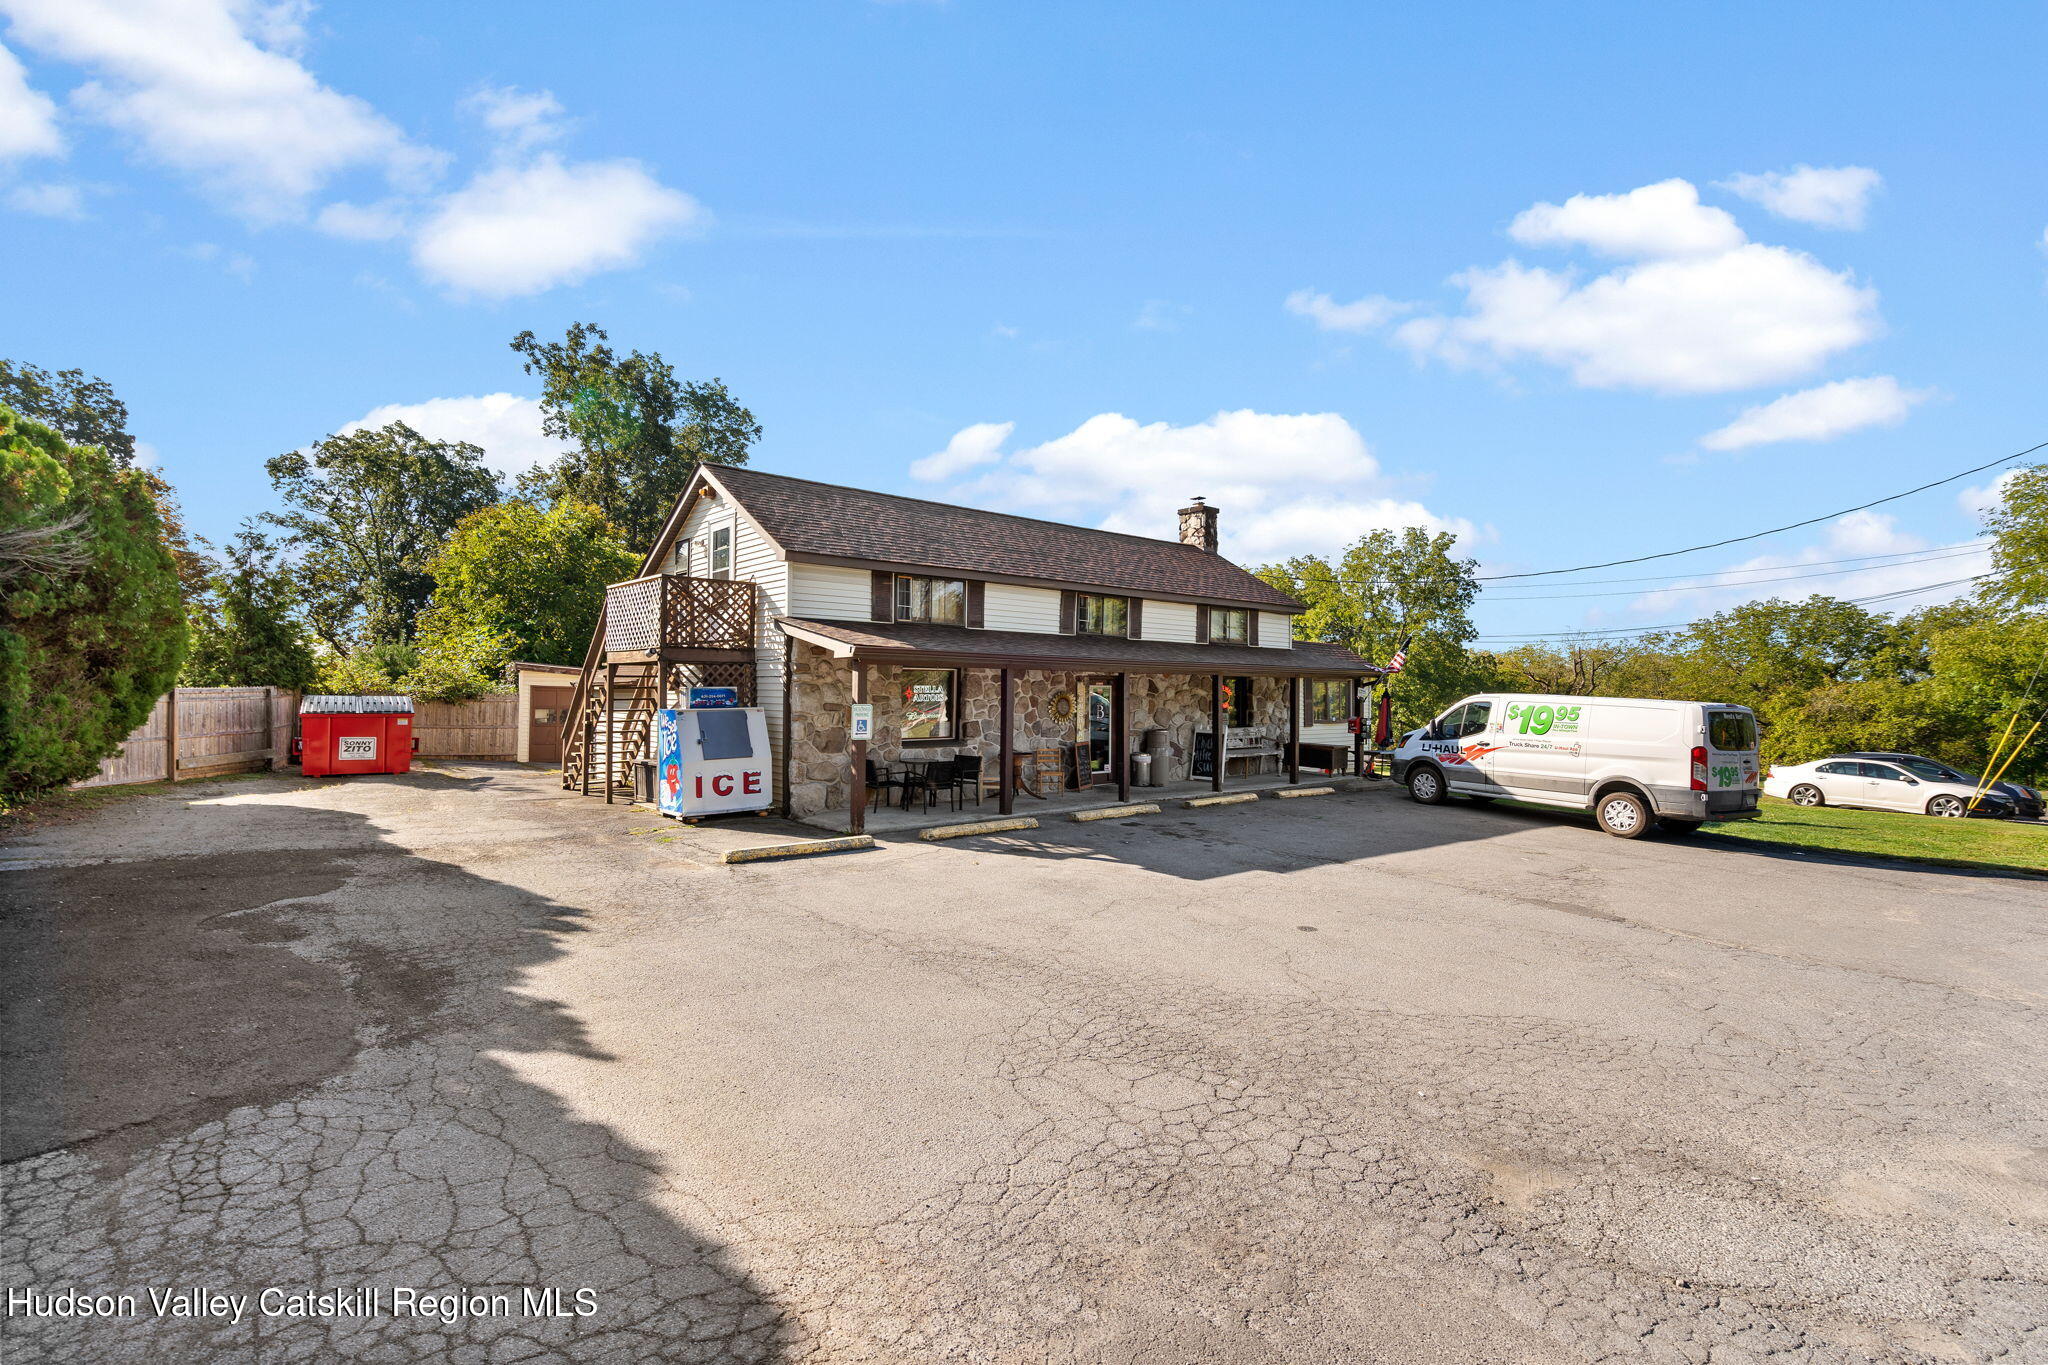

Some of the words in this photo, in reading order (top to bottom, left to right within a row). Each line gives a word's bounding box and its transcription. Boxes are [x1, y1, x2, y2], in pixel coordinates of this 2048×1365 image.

[913, 685, 944, 693] STELLA
[912, 694, 944, 702] ARTOIS
[1422, 743, 1466, 755] U-HAUL
[695, 769, 762, 799] ICE
